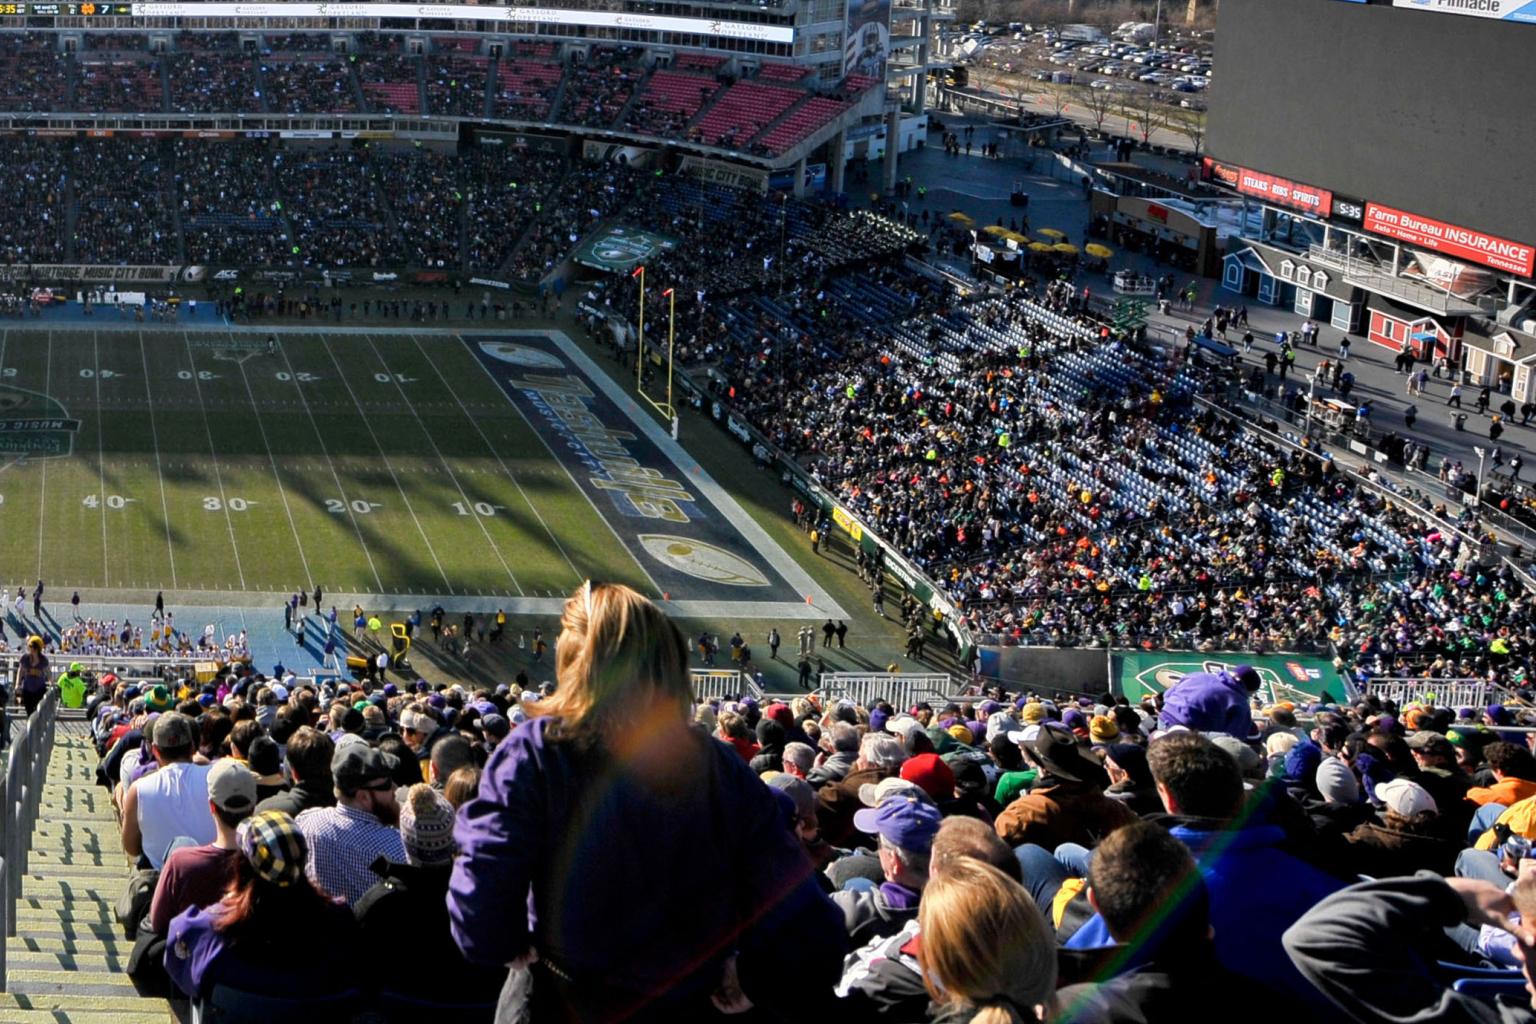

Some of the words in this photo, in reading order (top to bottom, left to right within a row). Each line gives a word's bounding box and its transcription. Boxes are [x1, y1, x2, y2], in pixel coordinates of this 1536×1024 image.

[101, 5, 109, 14] 7
[1243, 176, 1268, 191] STEAKS
[1271, 185, 1288, 197] RIBS
[1292, 190, 1320, 206] SPIRITS
[1339, 203, 1361, 218] 5:35
[1368, 207, 1398, 224] Farm
[1400, 216, 1442, 237] Bureau
[1445, 228, 1530, 262] INSURANCE
[1374, 223, 1391, 234] Auto
[1397, 230, 1417, 241] Home
[1424, 237, 1438, 247] Life
[1487, 256, 1527, 273] Tennessee
[83, 267, 114, 279] MUSIC
[114, 267, 137, 279] CITY
[213, 270, 240, 279] ACC
[13, 420, 64, 430] MUSIC
[82, 494, 126, 510] 40
[202, 497, 248, 513] 30
[324, 499, 372, 514] 20
[452, 501, 495, 517] 10
